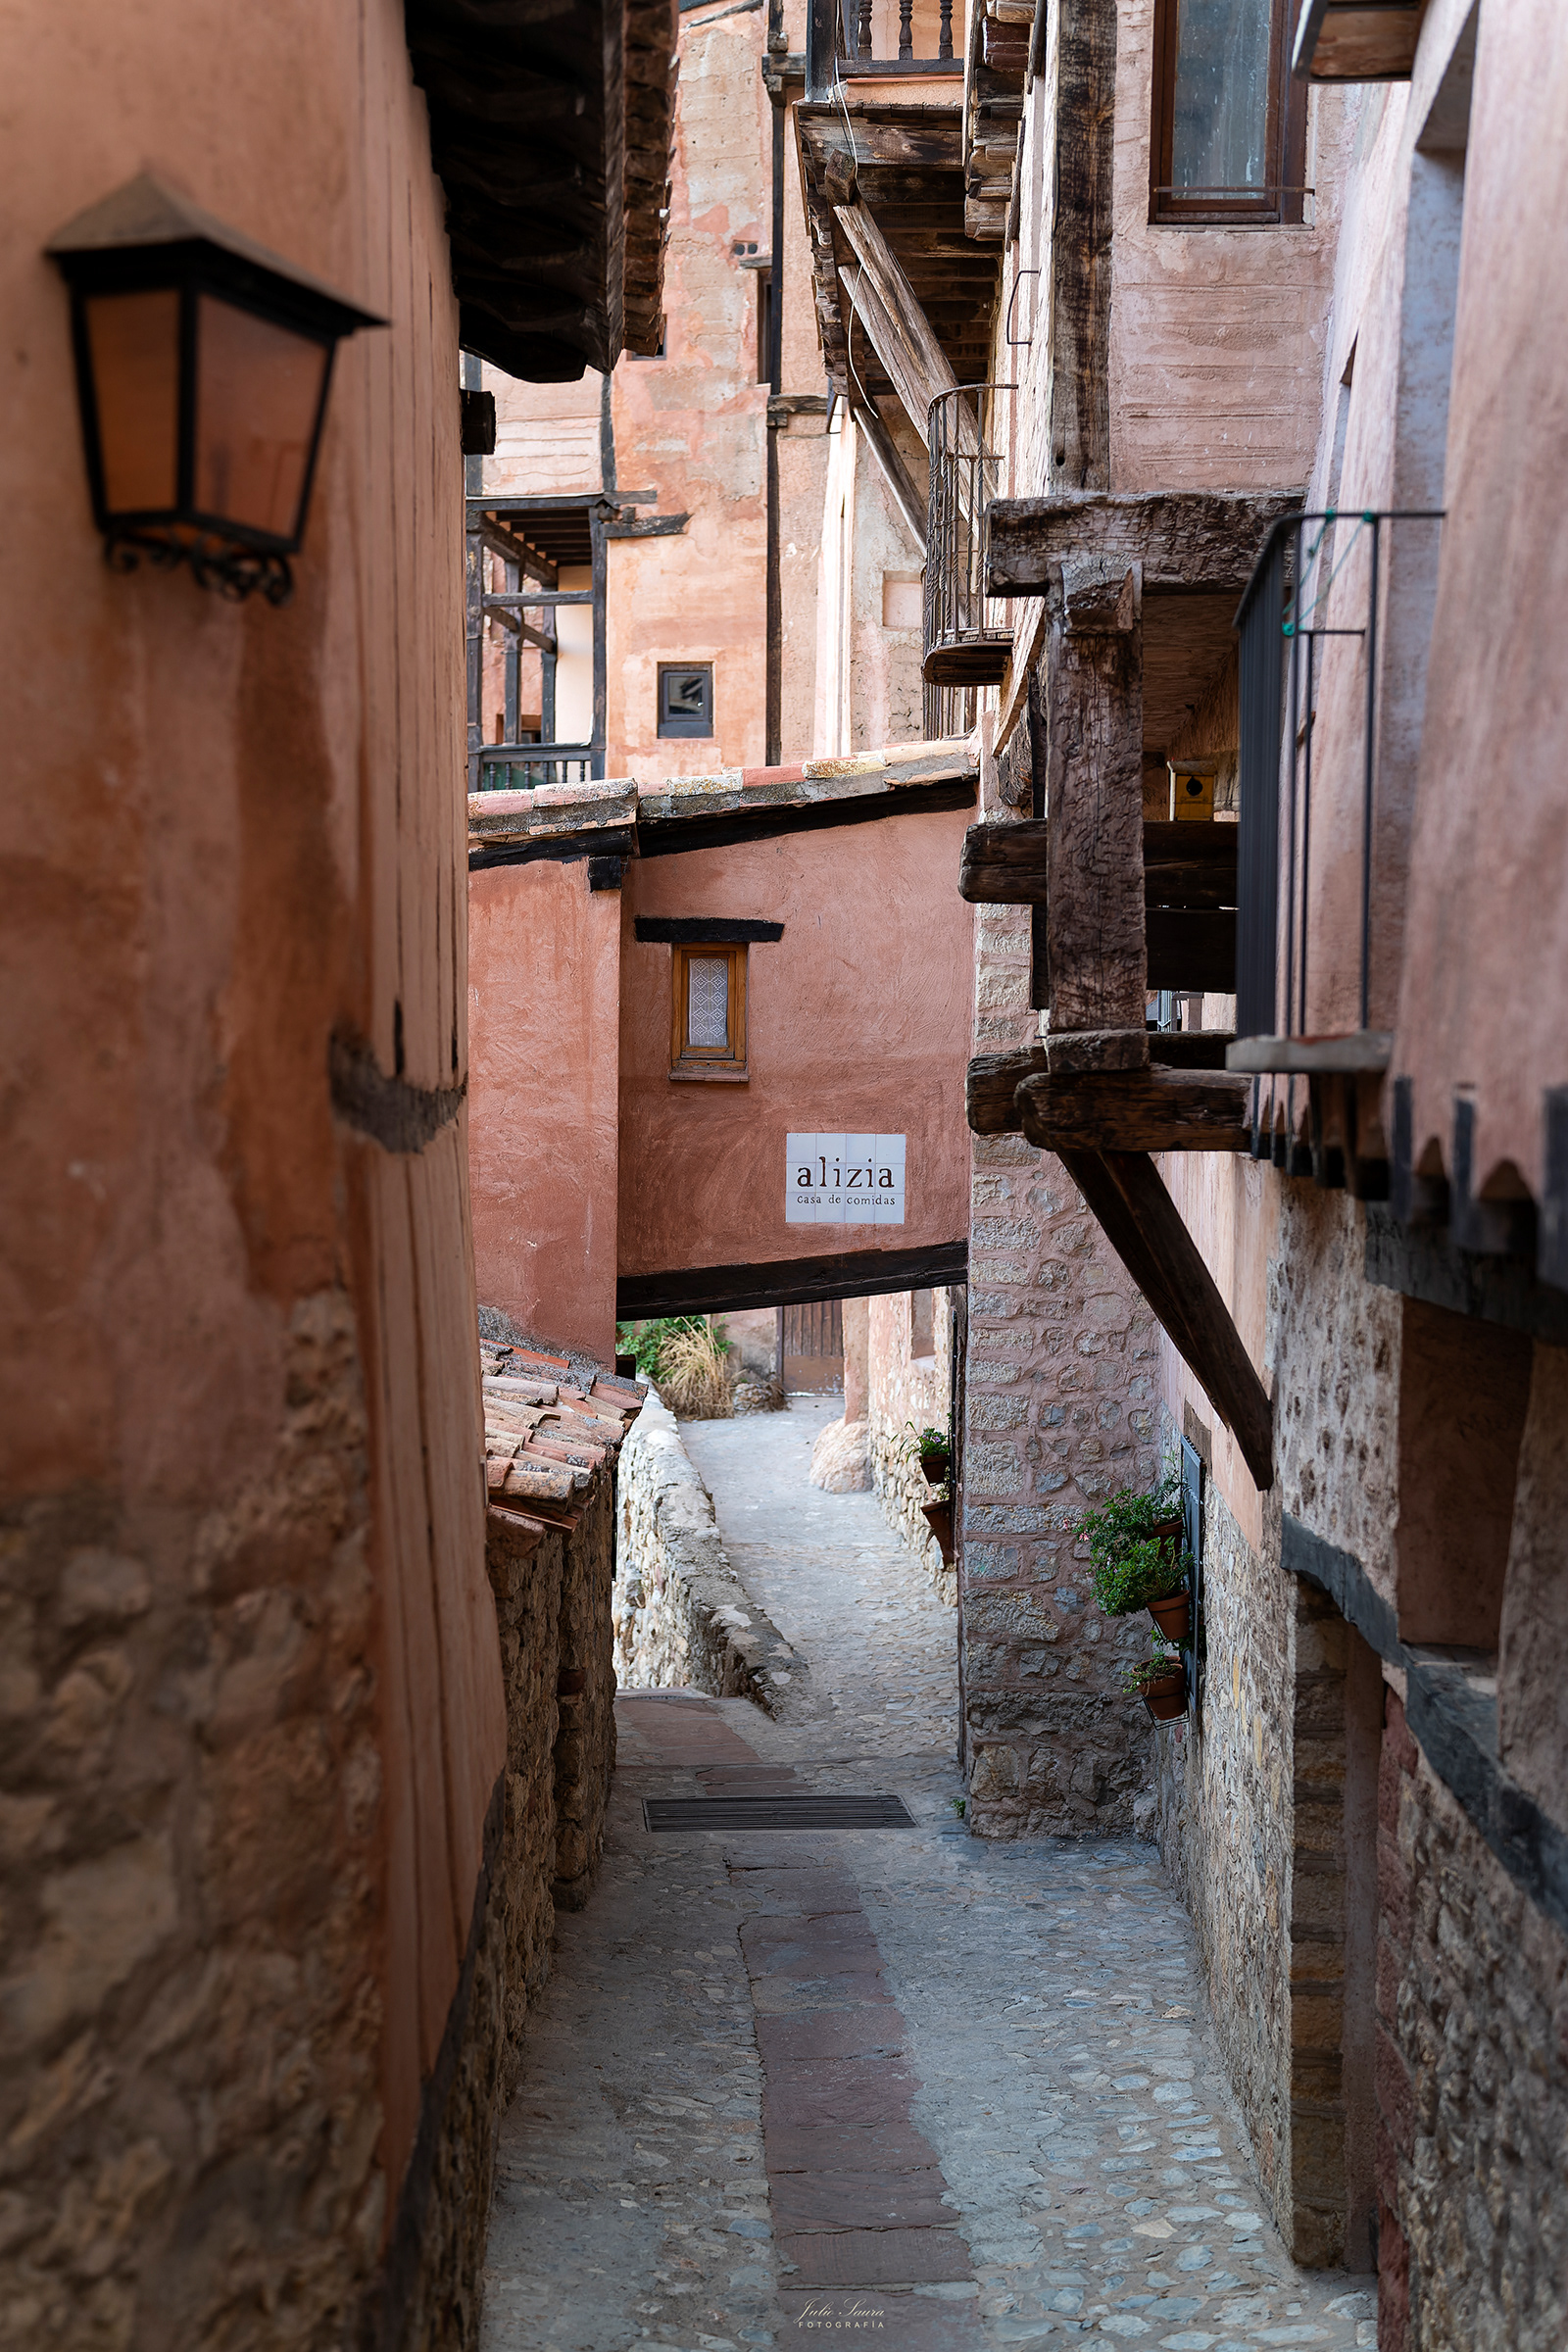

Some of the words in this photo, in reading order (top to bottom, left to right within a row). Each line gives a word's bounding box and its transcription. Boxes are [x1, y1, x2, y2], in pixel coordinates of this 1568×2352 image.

[797, 1155, 895, 1188] alizia
[797, 1195, 822, 1204] casa
[828, 1194, 841, 1204] de
[846, 1194, 896, 1205] comidas
